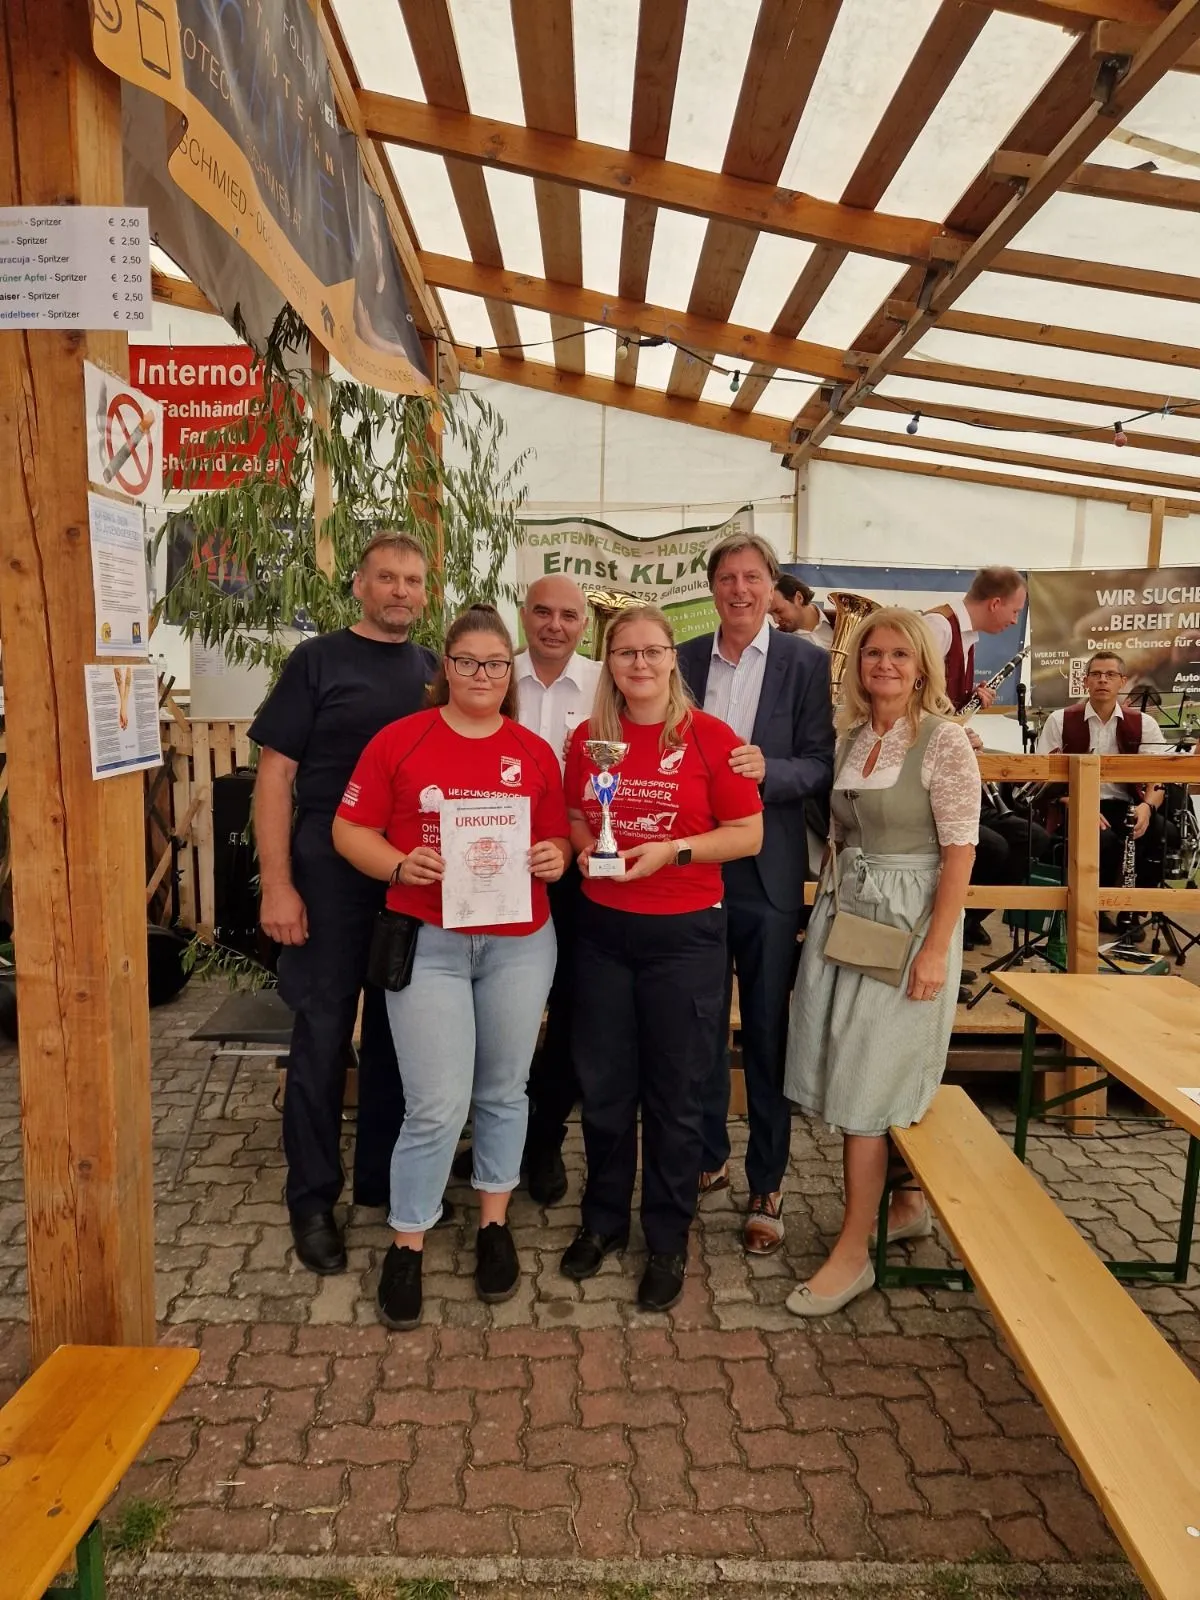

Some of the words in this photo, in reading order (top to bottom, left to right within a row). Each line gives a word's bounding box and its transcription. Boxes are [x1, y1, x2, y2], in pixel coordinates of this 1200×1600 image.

[30, 217, 62, 227] Spritzer
[108, 218, 116, 227] €
[120, 218, 140, 228] 2,50
[16, 236, 48, 246] Spritzer
[109, 236, 116, 245] €
[121, 236, 140, 246] 2,50
[37, 254, 70, 264] Spritzer
[110, 255, 117, 264] €
[122, 255, 141, 265] 2,50
[24, 273, 48, 283] Apfel
[54, 273, 88, 283] Spritzer
[111, 273, 118, 282] €
[123, 274, 143, 283] 2,50
[28, 291, 60, 301] Spritzer
[112, 292, 119, 300] €
[124, 293, 143, 302] 2,50
[47, 309, 80, 319] Spritzer
[113, 310, 120, 319] €
[125, 311, 145, 320] 2,50
[138, 358, 267, 386] Internor
[528, 531, 642, 558] GARTENPFLEGE
[543, 551, 618, 581] Ernst
[1096, 589, 1136, 606] WIR
[1087, 638, 1123, 650] Deine
[1125, 637, 1171, 649] Chance
[1174, 635, 1193, 647] für
[455, 815, 517, 828] URKUNDE
